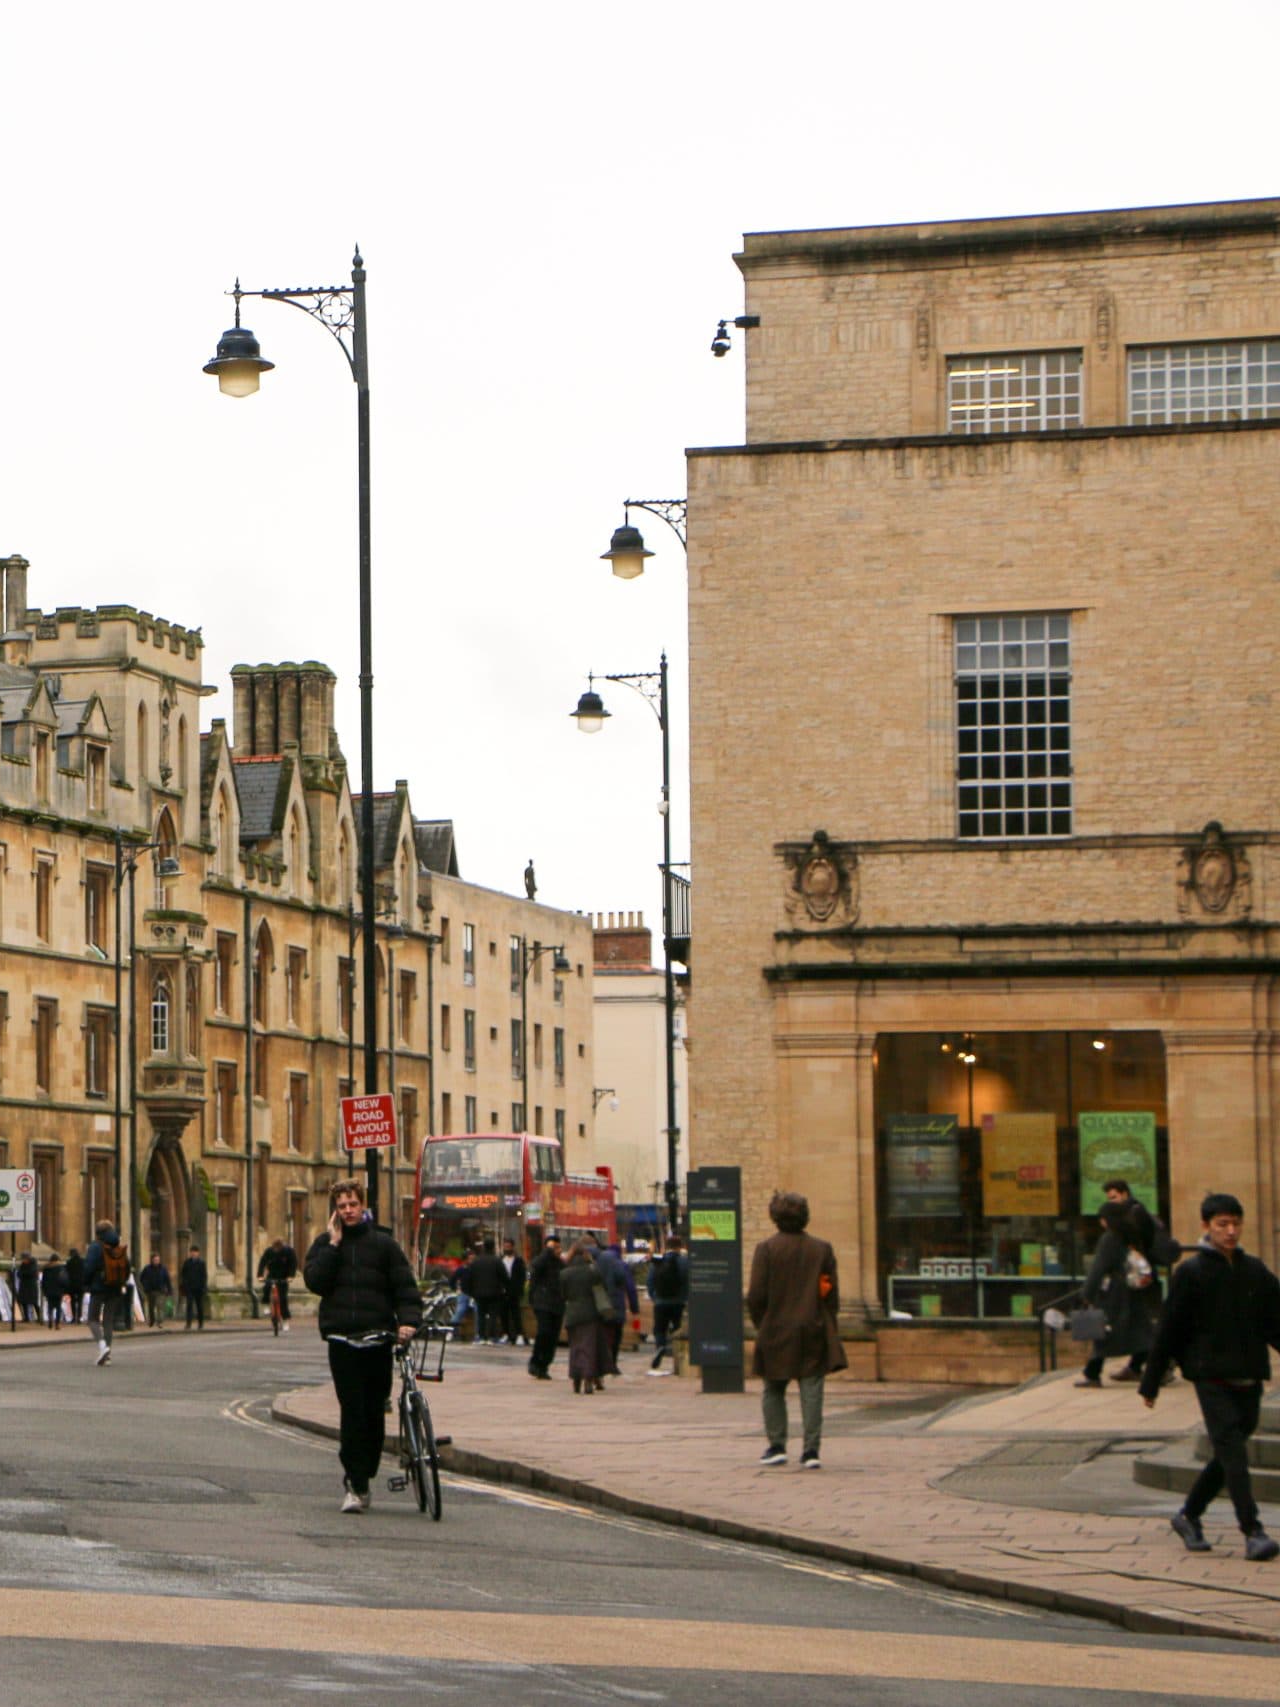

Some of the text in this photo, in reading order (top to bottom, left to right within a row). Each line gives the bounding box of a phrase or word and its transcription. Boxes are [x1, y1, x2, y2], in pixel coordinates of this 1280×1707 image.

[354, 1099, 380, 1110] NEW
[352, 1110, 384, 1122] ROAD
[349, 1121, 391, 1135] LAYOUT
[352, 1133, 390, 1146] AHEAD
